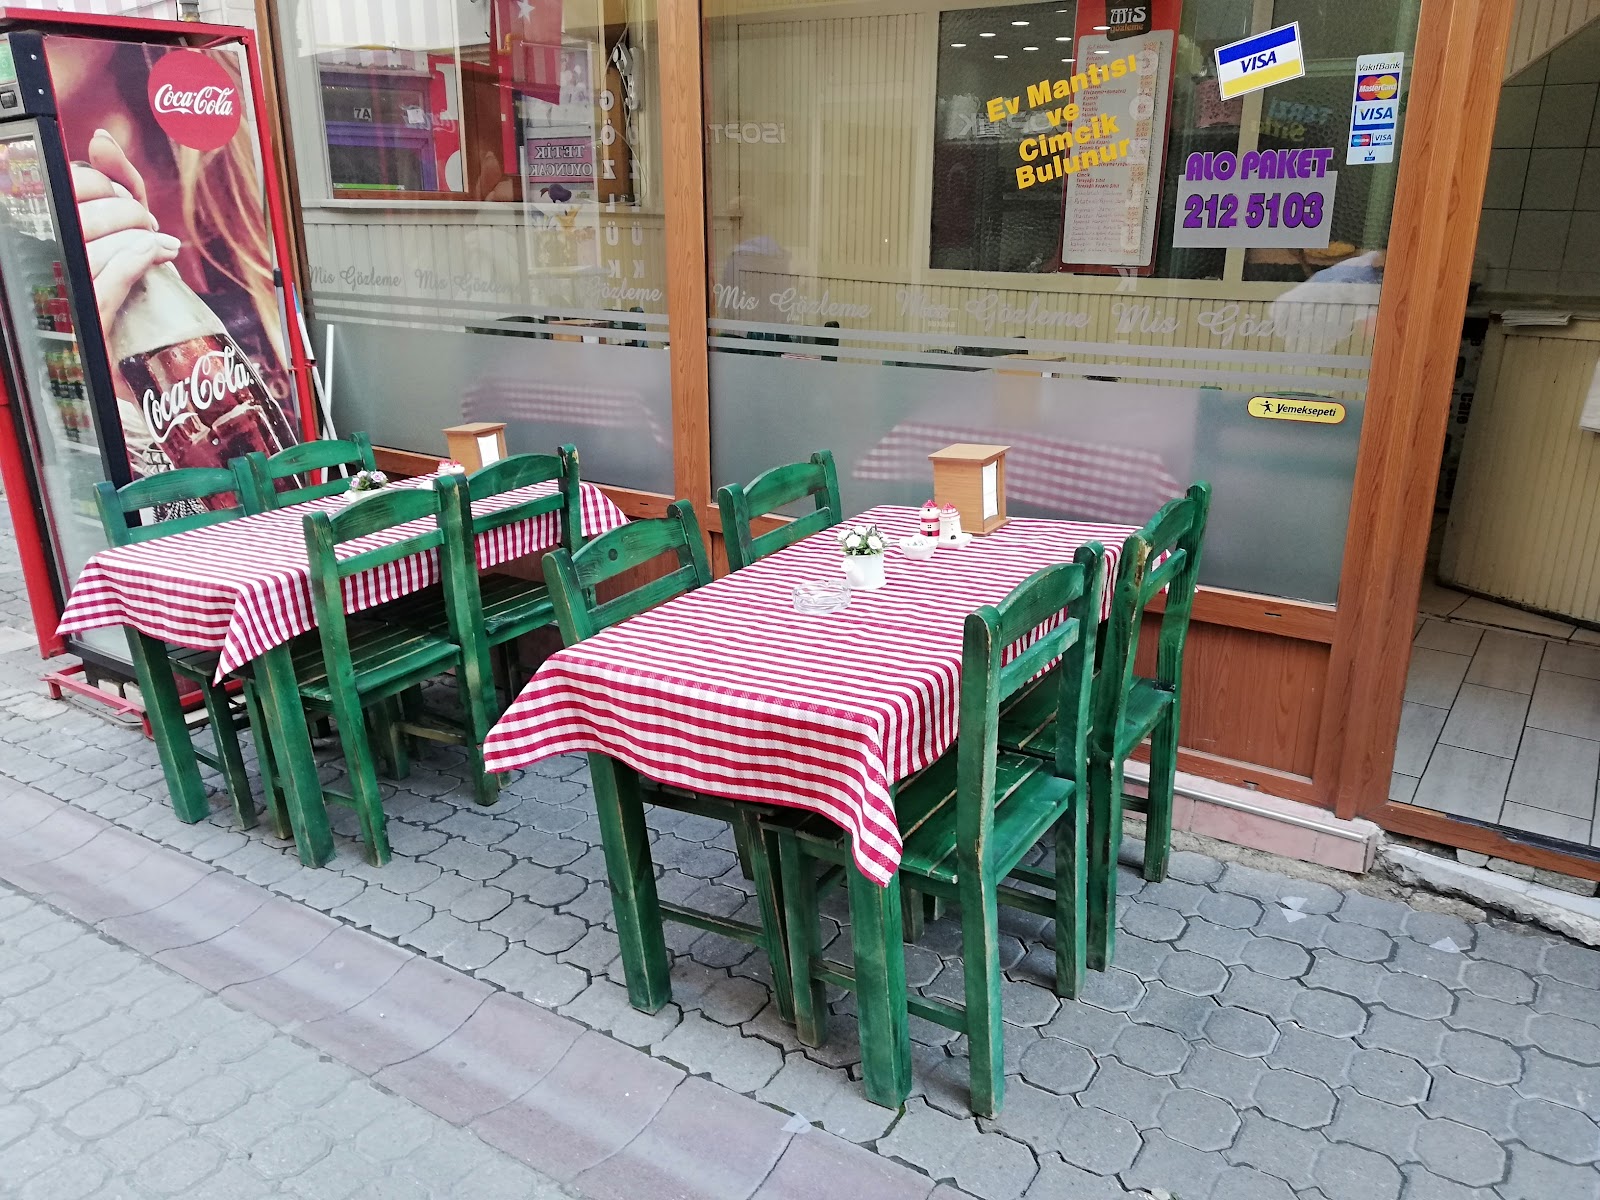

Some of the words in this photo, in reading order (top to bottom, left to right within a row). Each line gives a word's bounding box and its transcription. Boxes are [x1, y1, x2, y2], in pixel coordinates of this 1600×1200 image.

[1240, 50, 1277, 74] VISA
[986, 95, 1020, 123] Ev
[1026, 54, 1137, 109] Mantısı
[1358, 83, 1398, 93] MasterCard
[354, 108, 371, 119] 7A
[1045, 103, 1080, 127] ve
[1360, 106, 1393, 121] VISA
[1019, 112, 1120, 162] Cimcik
[1015, 138, 1131, 190] Bulunur
[1185, 151, 1237, 181] ALO
[1240, 147, 1334, 180] PAKET
[1182, 193, 1239, 228] 212
[1244, 191, 1324, 228] 5103
[340, 265, 401, 292] Gözleme
[713, 283, 760, 311] Mis
[769, 287, 873, 320] Gözleme
[965, 293, 1092, 333] Gözleme
[1111, 302, 1181, 335] Mis
